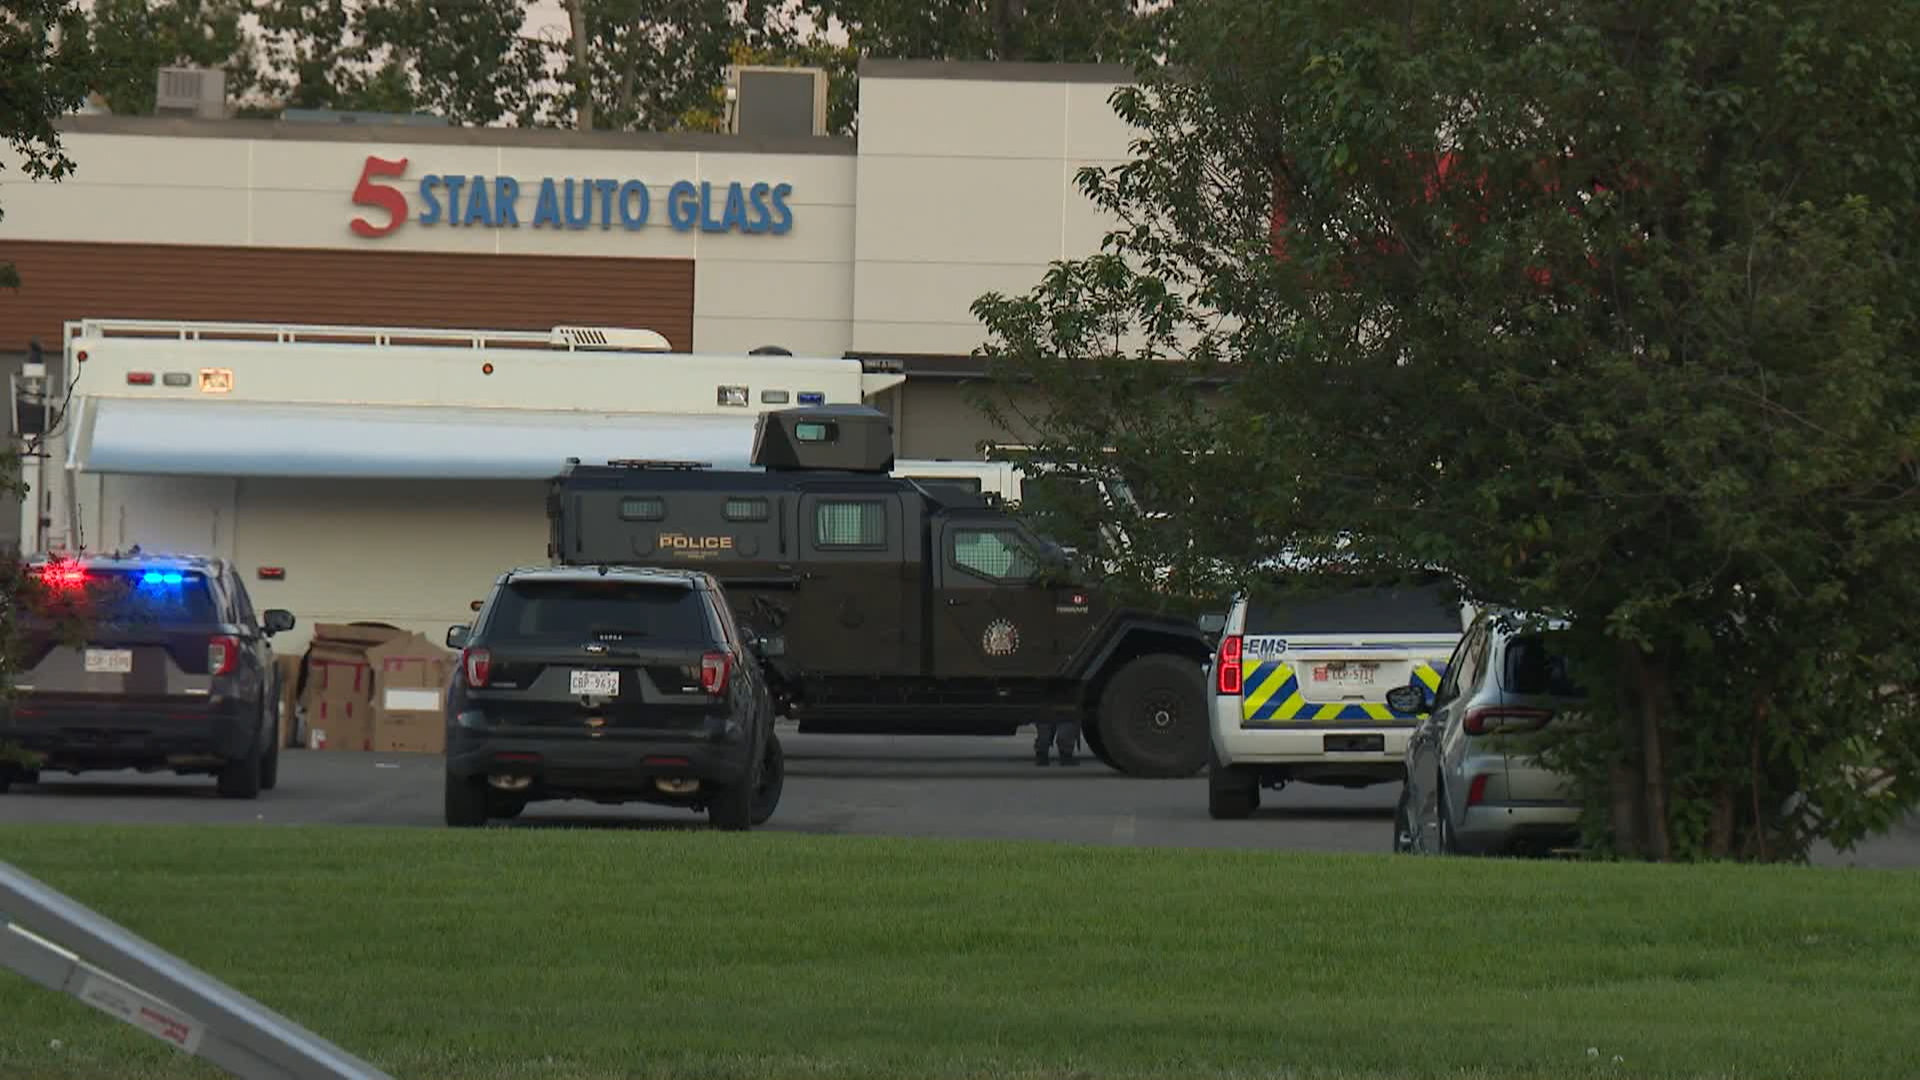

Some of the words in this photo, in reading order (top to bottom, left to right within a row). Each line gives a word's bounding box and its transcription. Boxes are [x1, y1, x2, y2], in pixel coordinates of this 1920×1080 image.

[350, 155, 409, 237] 5
[419, 174, 520, 228] STAR
[533, 177, 651, 231] AUTO
[667, 180, 794, 235] GLASS
[659, 536, 733, 549] POLICE
[1247, 638, 1288, 654] EMS
